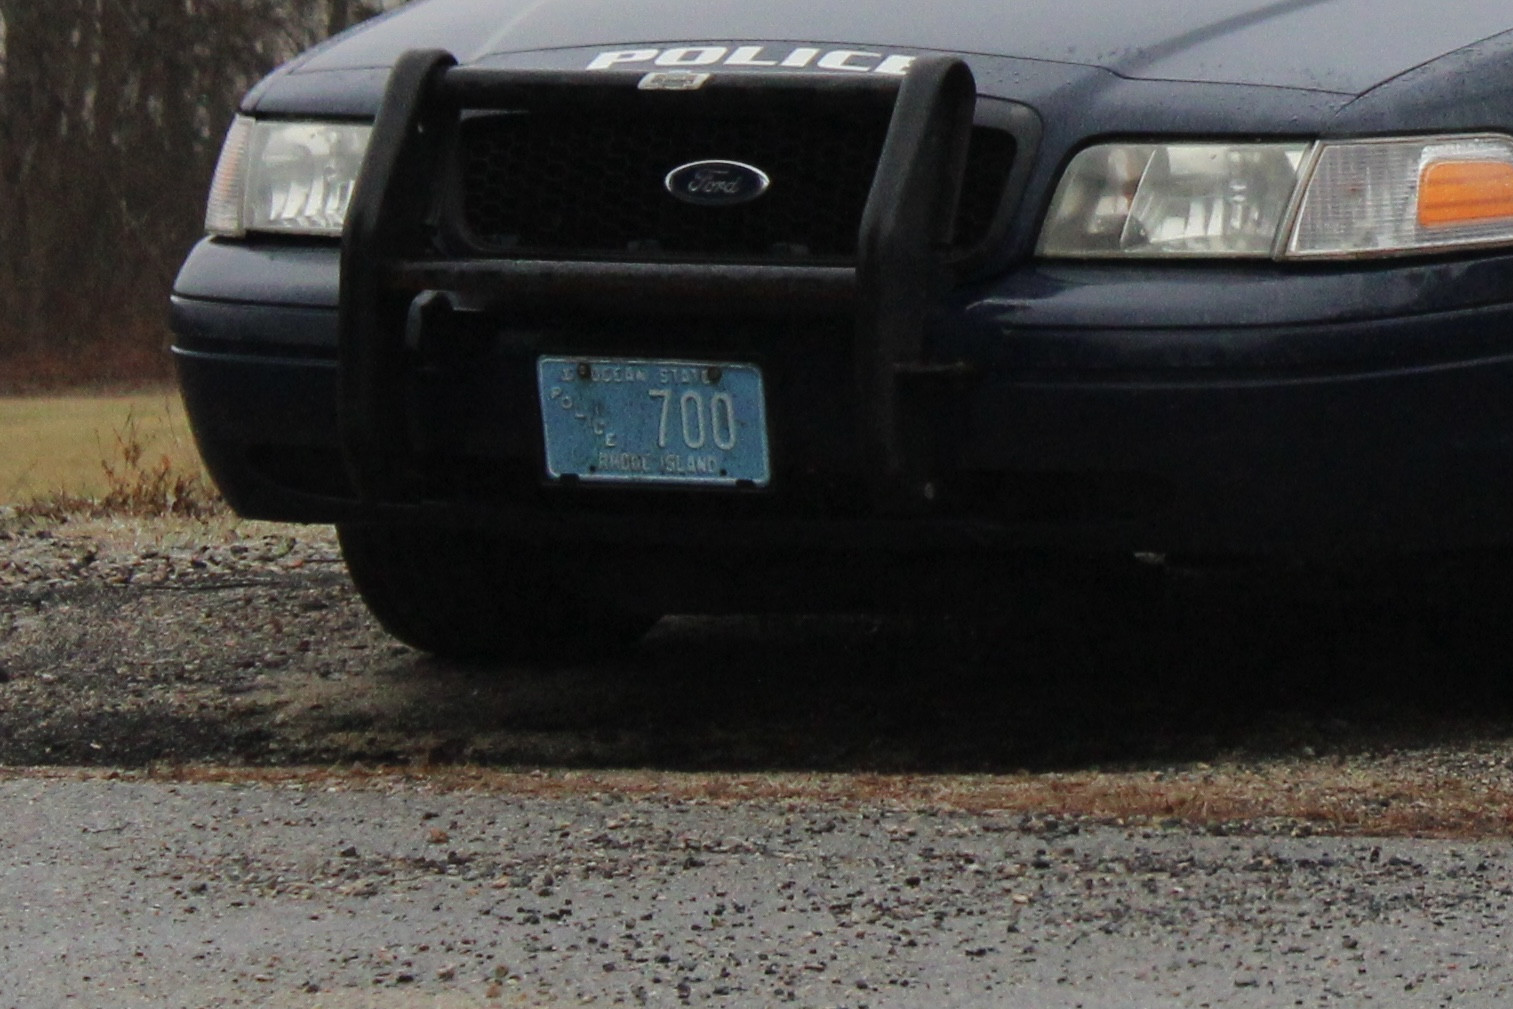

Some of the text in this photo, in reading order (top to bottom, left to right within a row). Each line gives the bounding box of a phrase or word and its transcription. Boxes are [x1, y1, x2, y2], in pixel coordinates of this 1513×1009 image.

[586, 45, 917, 75] POLICE
[687, 169, 742, 194] Ford
[648, 388, 737, 451] 700
[598, 451, 718, 473] RHODE ISLAND
